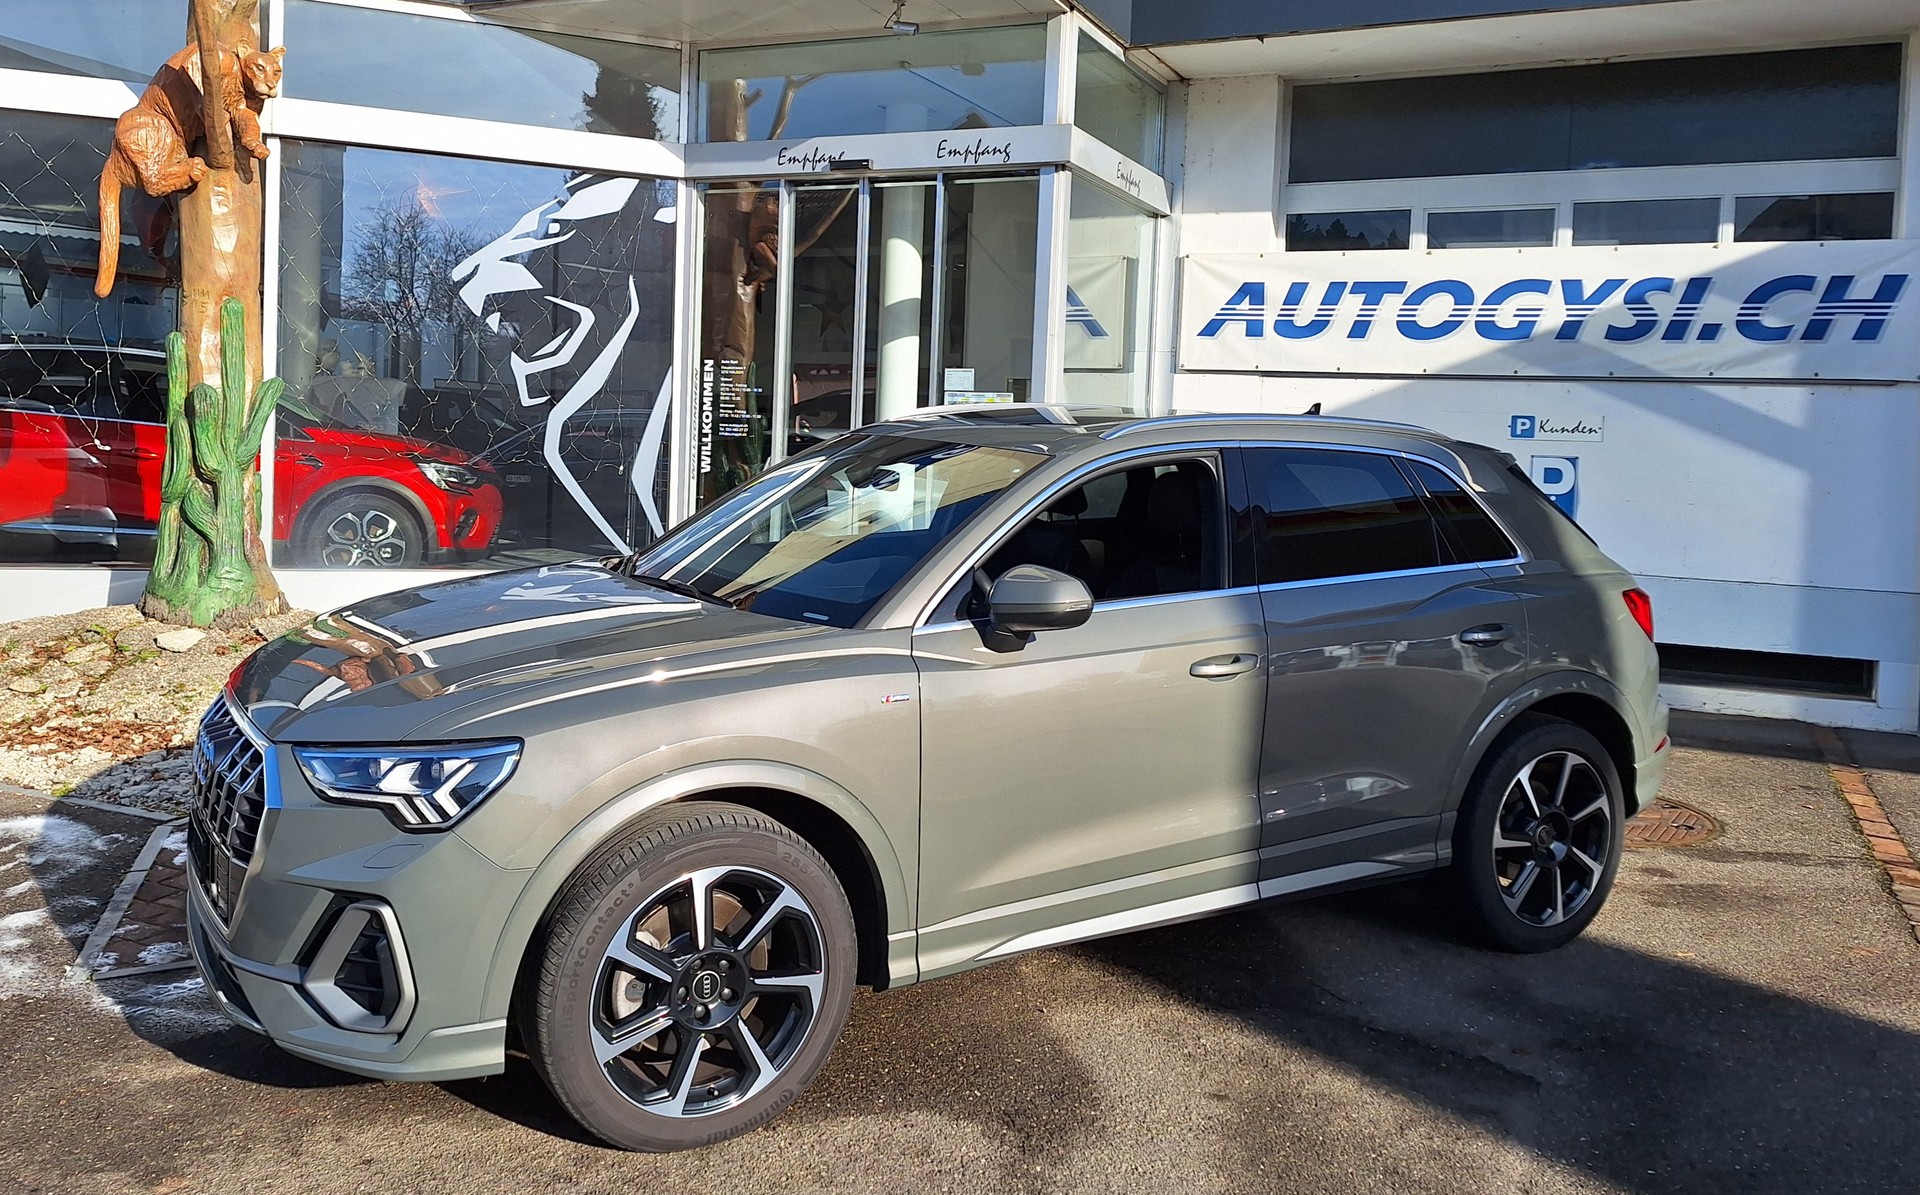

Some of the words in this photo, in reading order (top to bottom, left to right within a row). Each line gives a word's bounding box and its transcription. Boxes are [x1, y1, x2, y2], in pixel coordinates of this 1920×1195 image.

[936, 138, 1012, 165] Empfang
[1116, 161, 1141, 197] Empfang
[1195, 273, 1910, 342] AUTOGYSI.CH
[700, 359, 715, 474] WILLKOMMEN
[1516, 418, 1531, 435] P
[1538, 418, 1599, 435] Kunden
